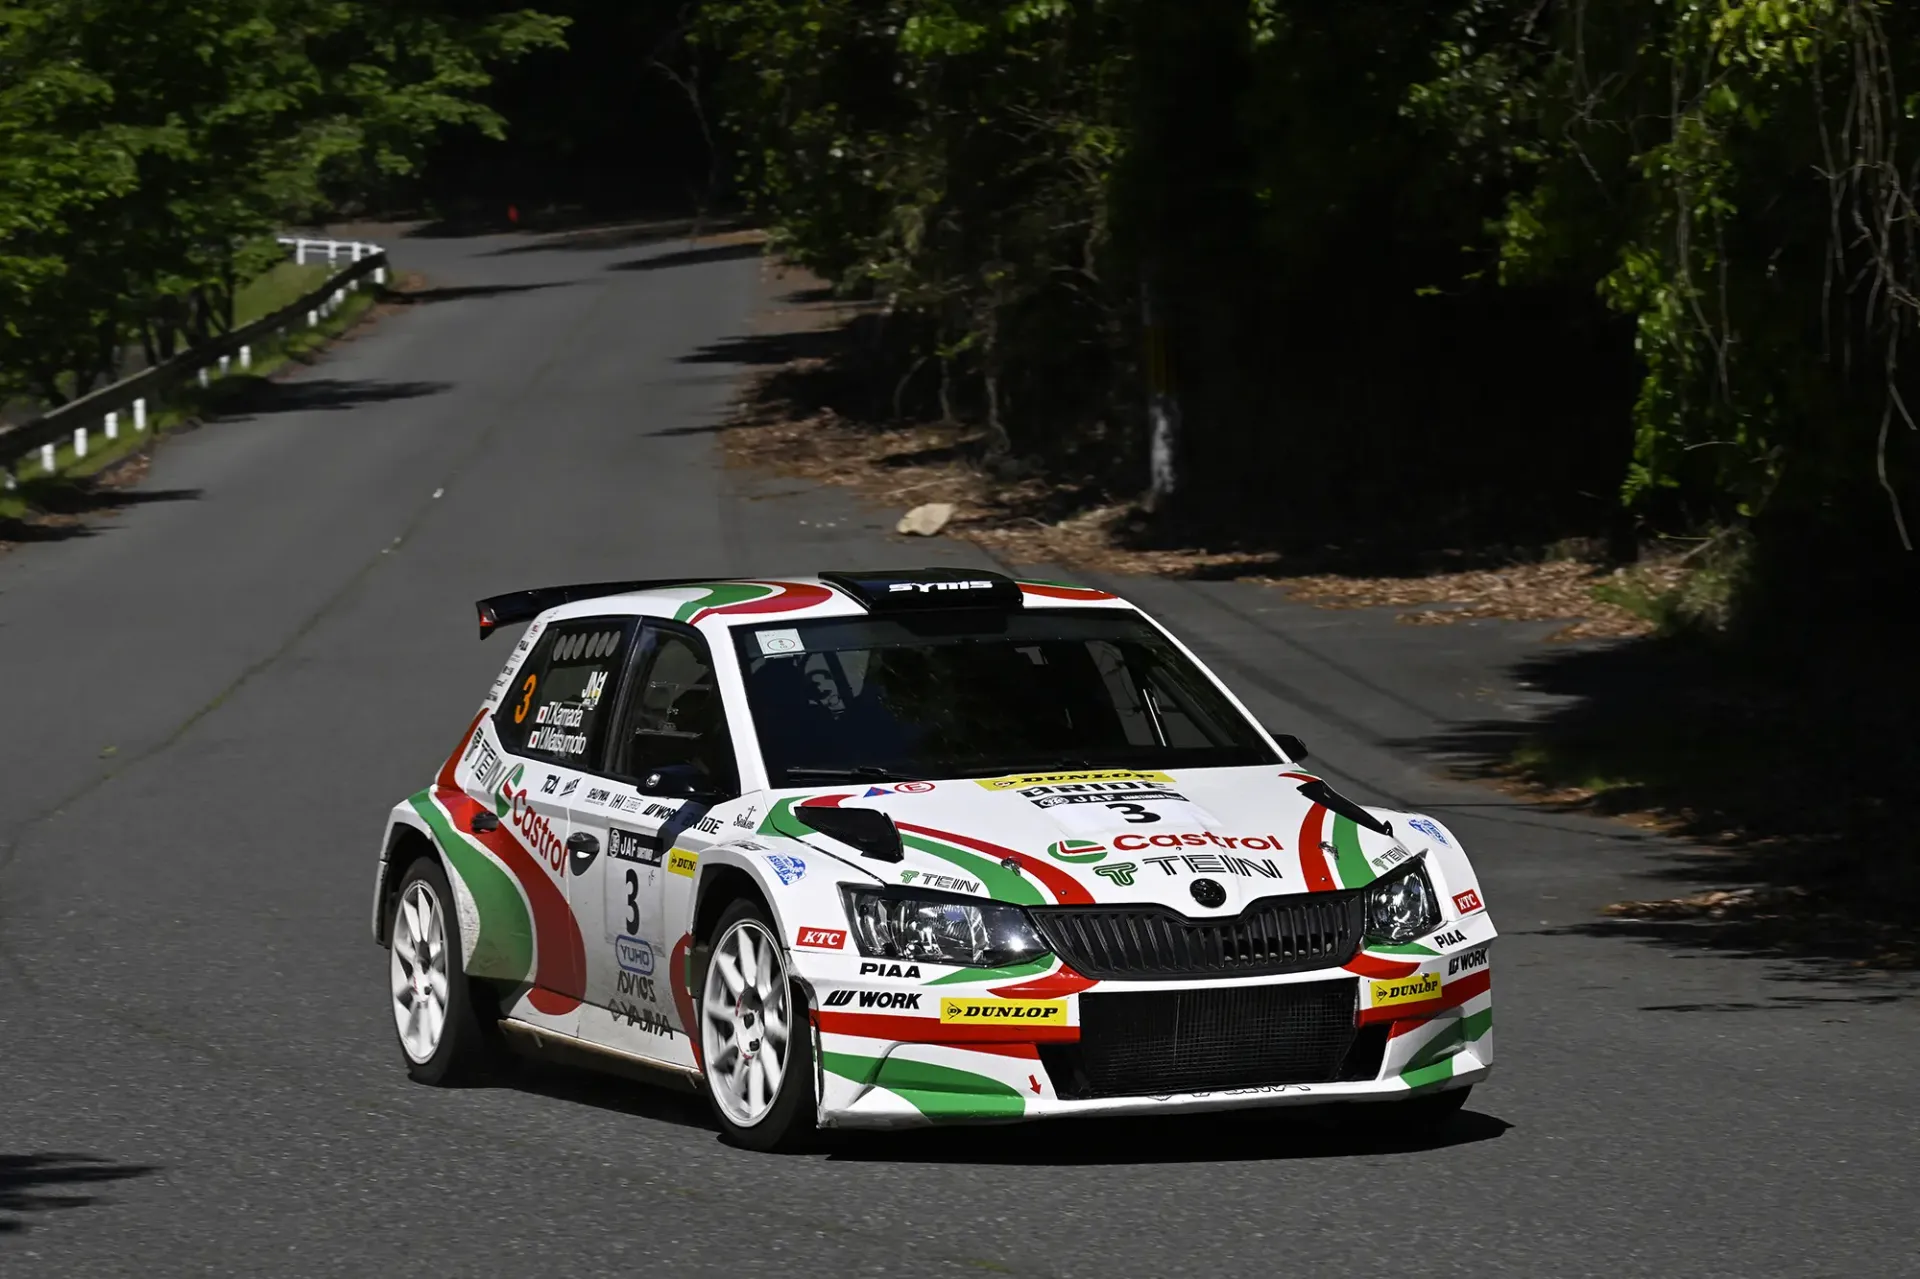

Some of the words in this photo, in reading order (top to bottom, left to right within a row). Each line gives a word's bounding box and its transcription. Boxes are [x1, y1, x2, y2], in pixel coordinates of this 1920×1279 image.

[514, 674, 537, 724] 3
[1020, 772, 1155, 784] DUNLOP
[1016, 781, 1175, 798] BRIDE
[1073, 794, 1115, 803] JAF
[609, 793, 627, 809] IHI
[1105, 803, 1161, 824] 3
[512, 789, 568, 878] Castrol
[1113, 831, 1284, 850] Castrol
[620, 836, 637, 857] JAF
[1142, 854, 1283, 878] TEIN
[922, 873, 980, 894] TEIN
[626, 868, 639, 935] 3
[1458, 894, 1477, 910] KTC
[802, 930, 841, 945] KTC
[1433, 929, 1467, 948] PIAA
[1460, 948, 1488, 971] WORK
[860, 962, 921, 979] PIAA
[1389, 980, 1438, 998] DUNLOP
[859, 991, 923, 1010] WORK
[963, 1005, 1058, 1018] DUNLOP
